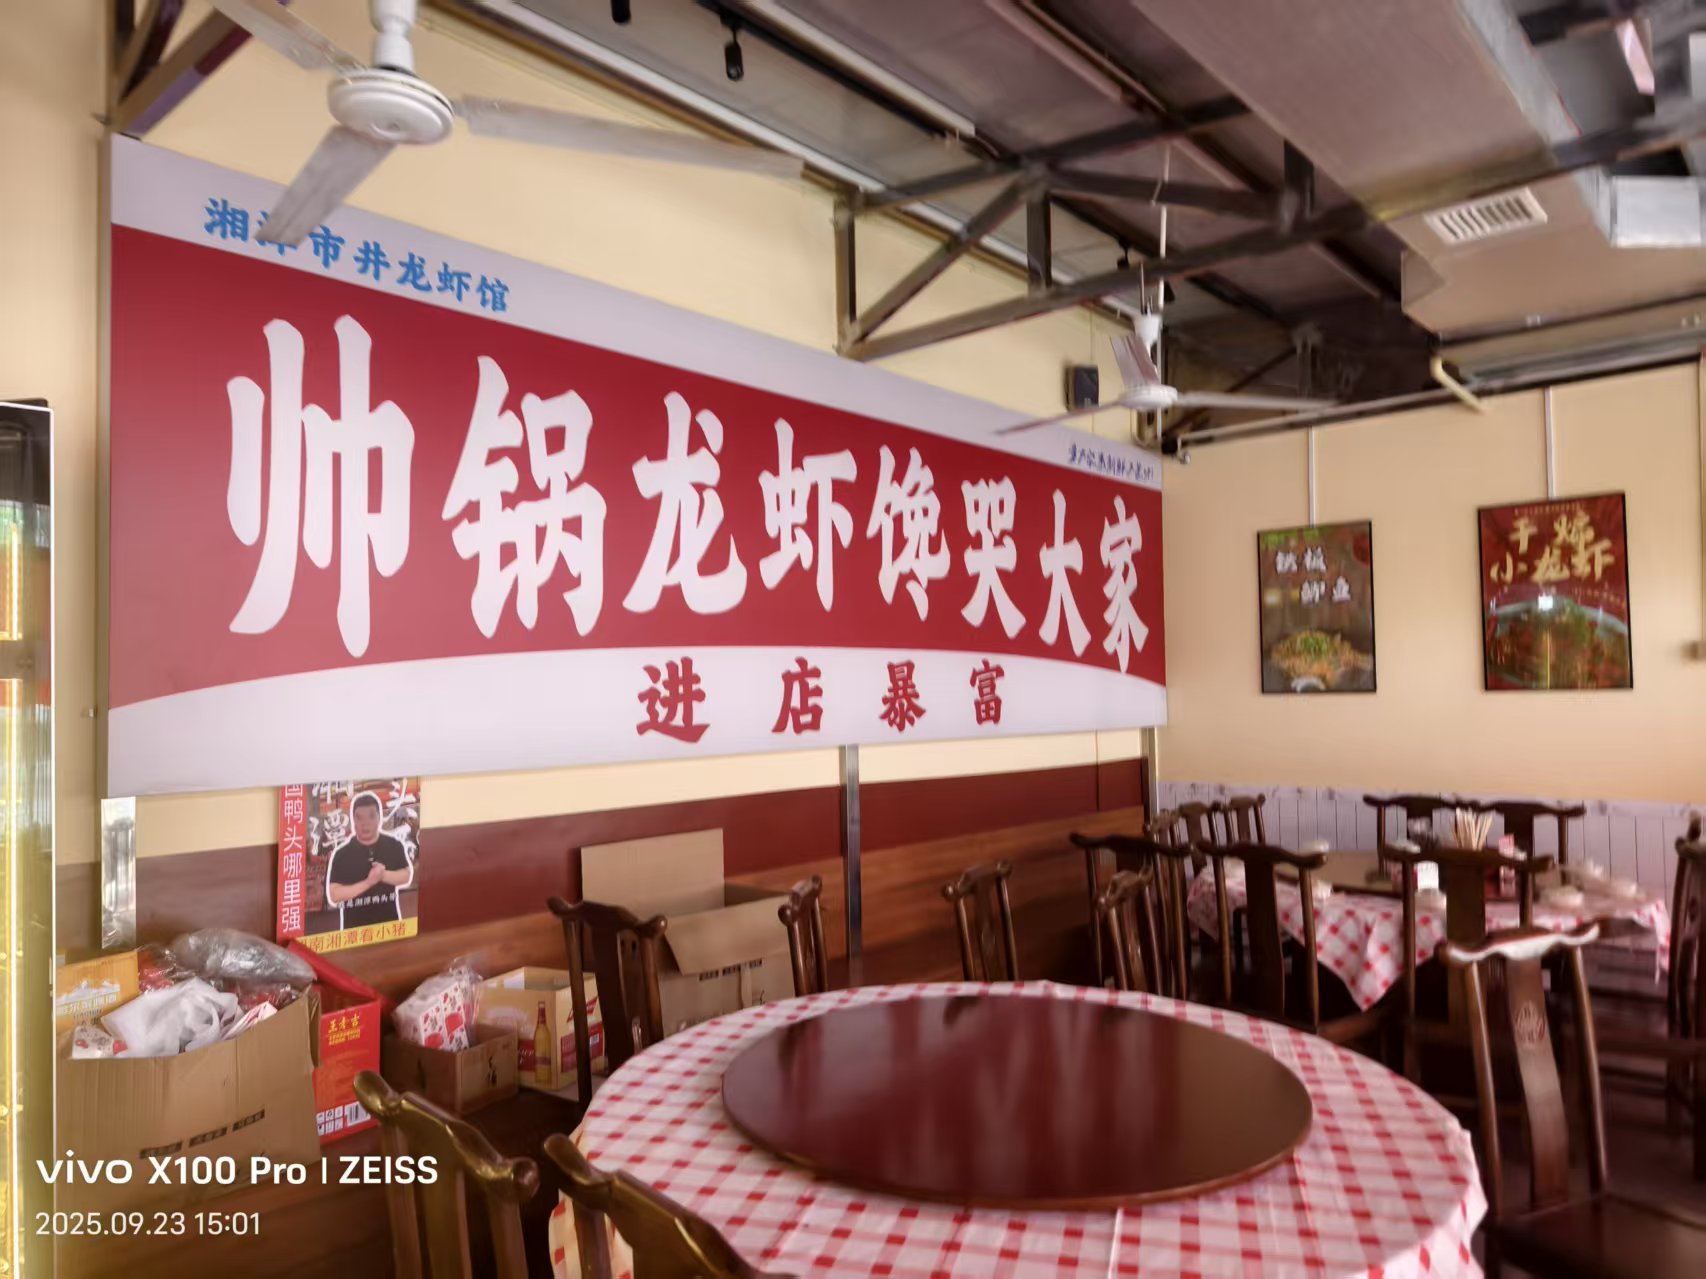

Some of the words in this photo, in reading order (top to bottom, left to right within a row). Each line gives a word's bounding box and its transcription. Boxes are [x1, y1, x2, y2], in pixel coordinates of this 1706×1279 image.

[226, 314, 1149, 674] 帅锅龙虾馋哭大家
[635, 656, 1005, 744] 进店暴富
